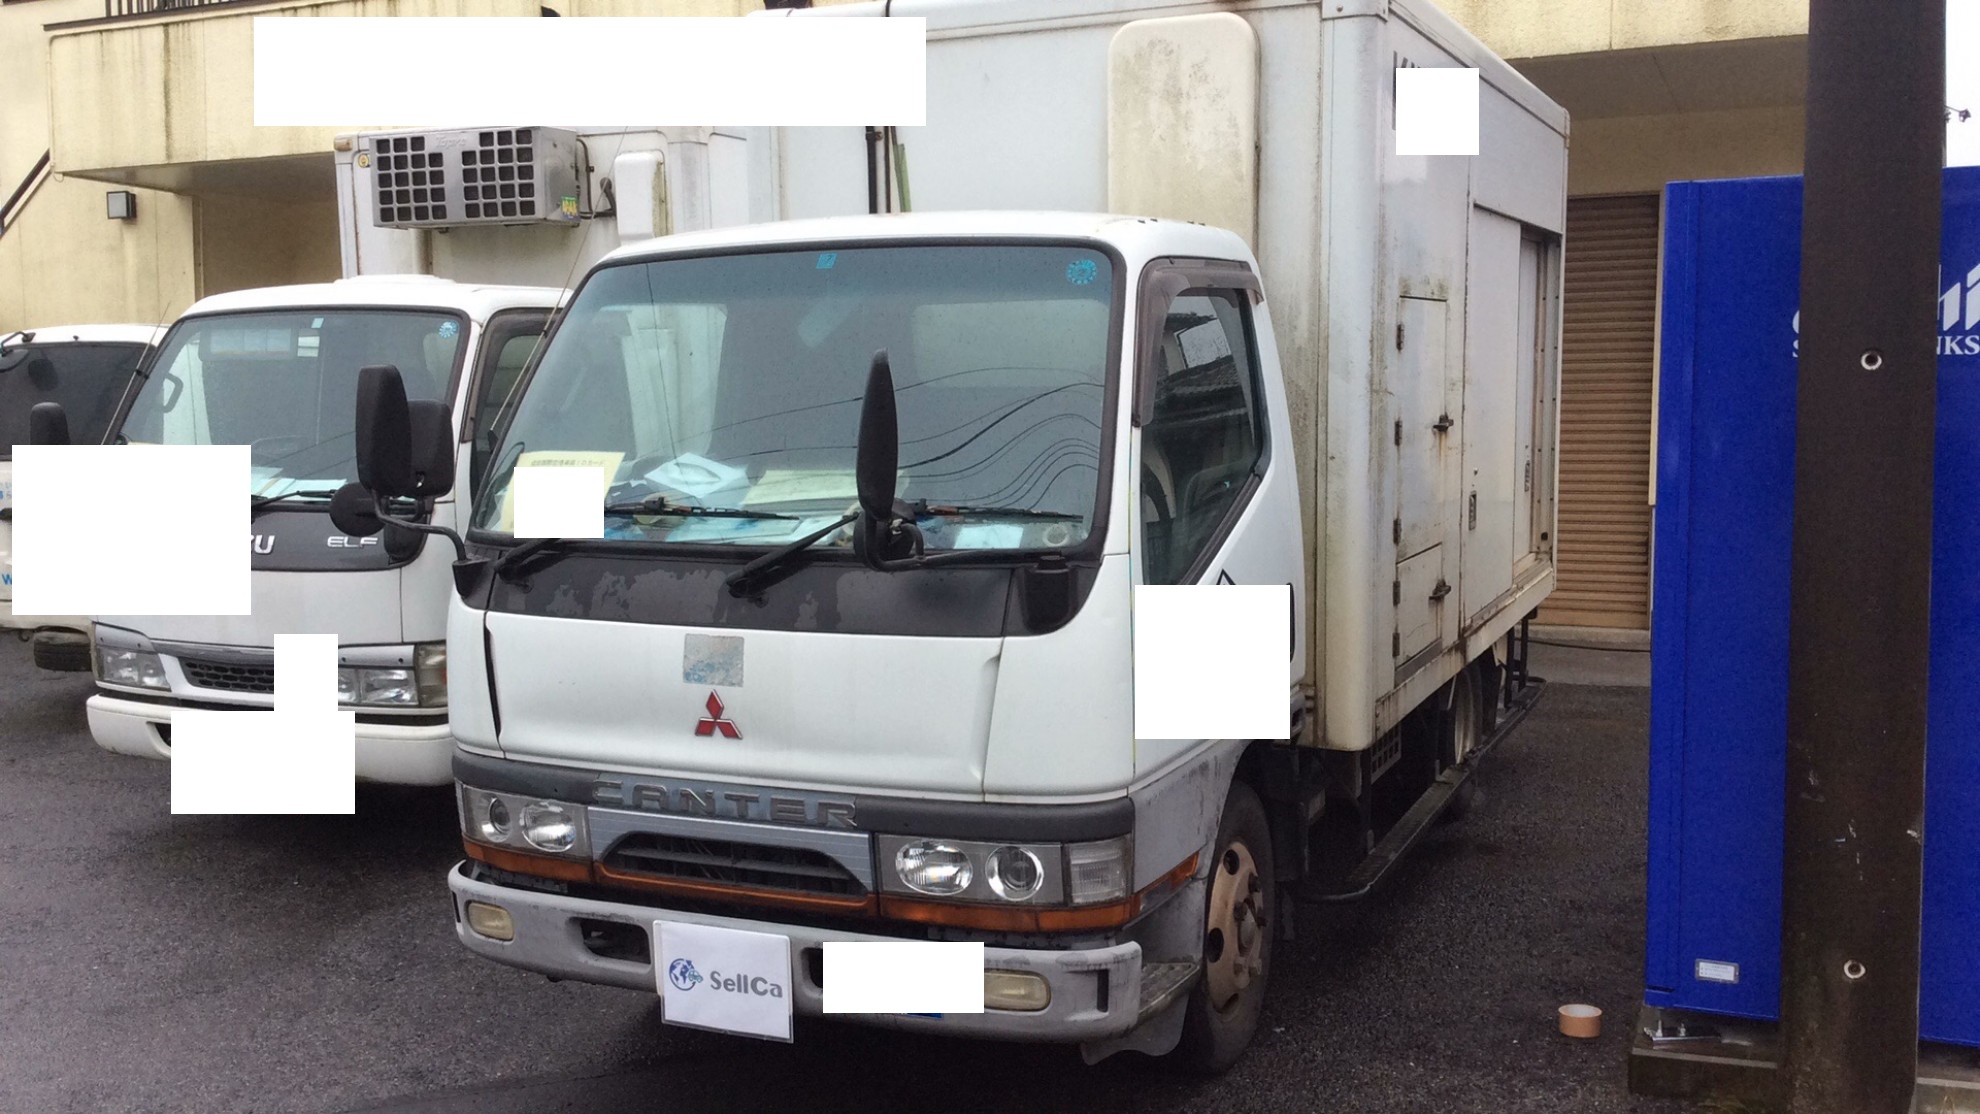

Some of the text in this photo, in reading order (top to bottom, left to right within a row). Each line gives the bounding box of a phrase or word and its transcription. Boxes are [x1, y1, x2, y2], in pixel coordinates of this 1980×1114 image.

[251, 534, 275, 554] U
[327, 536, 378, 548] ELF
[593, 779, 858, 828] CANTER
[710, 970, 783, 998] SellCa
